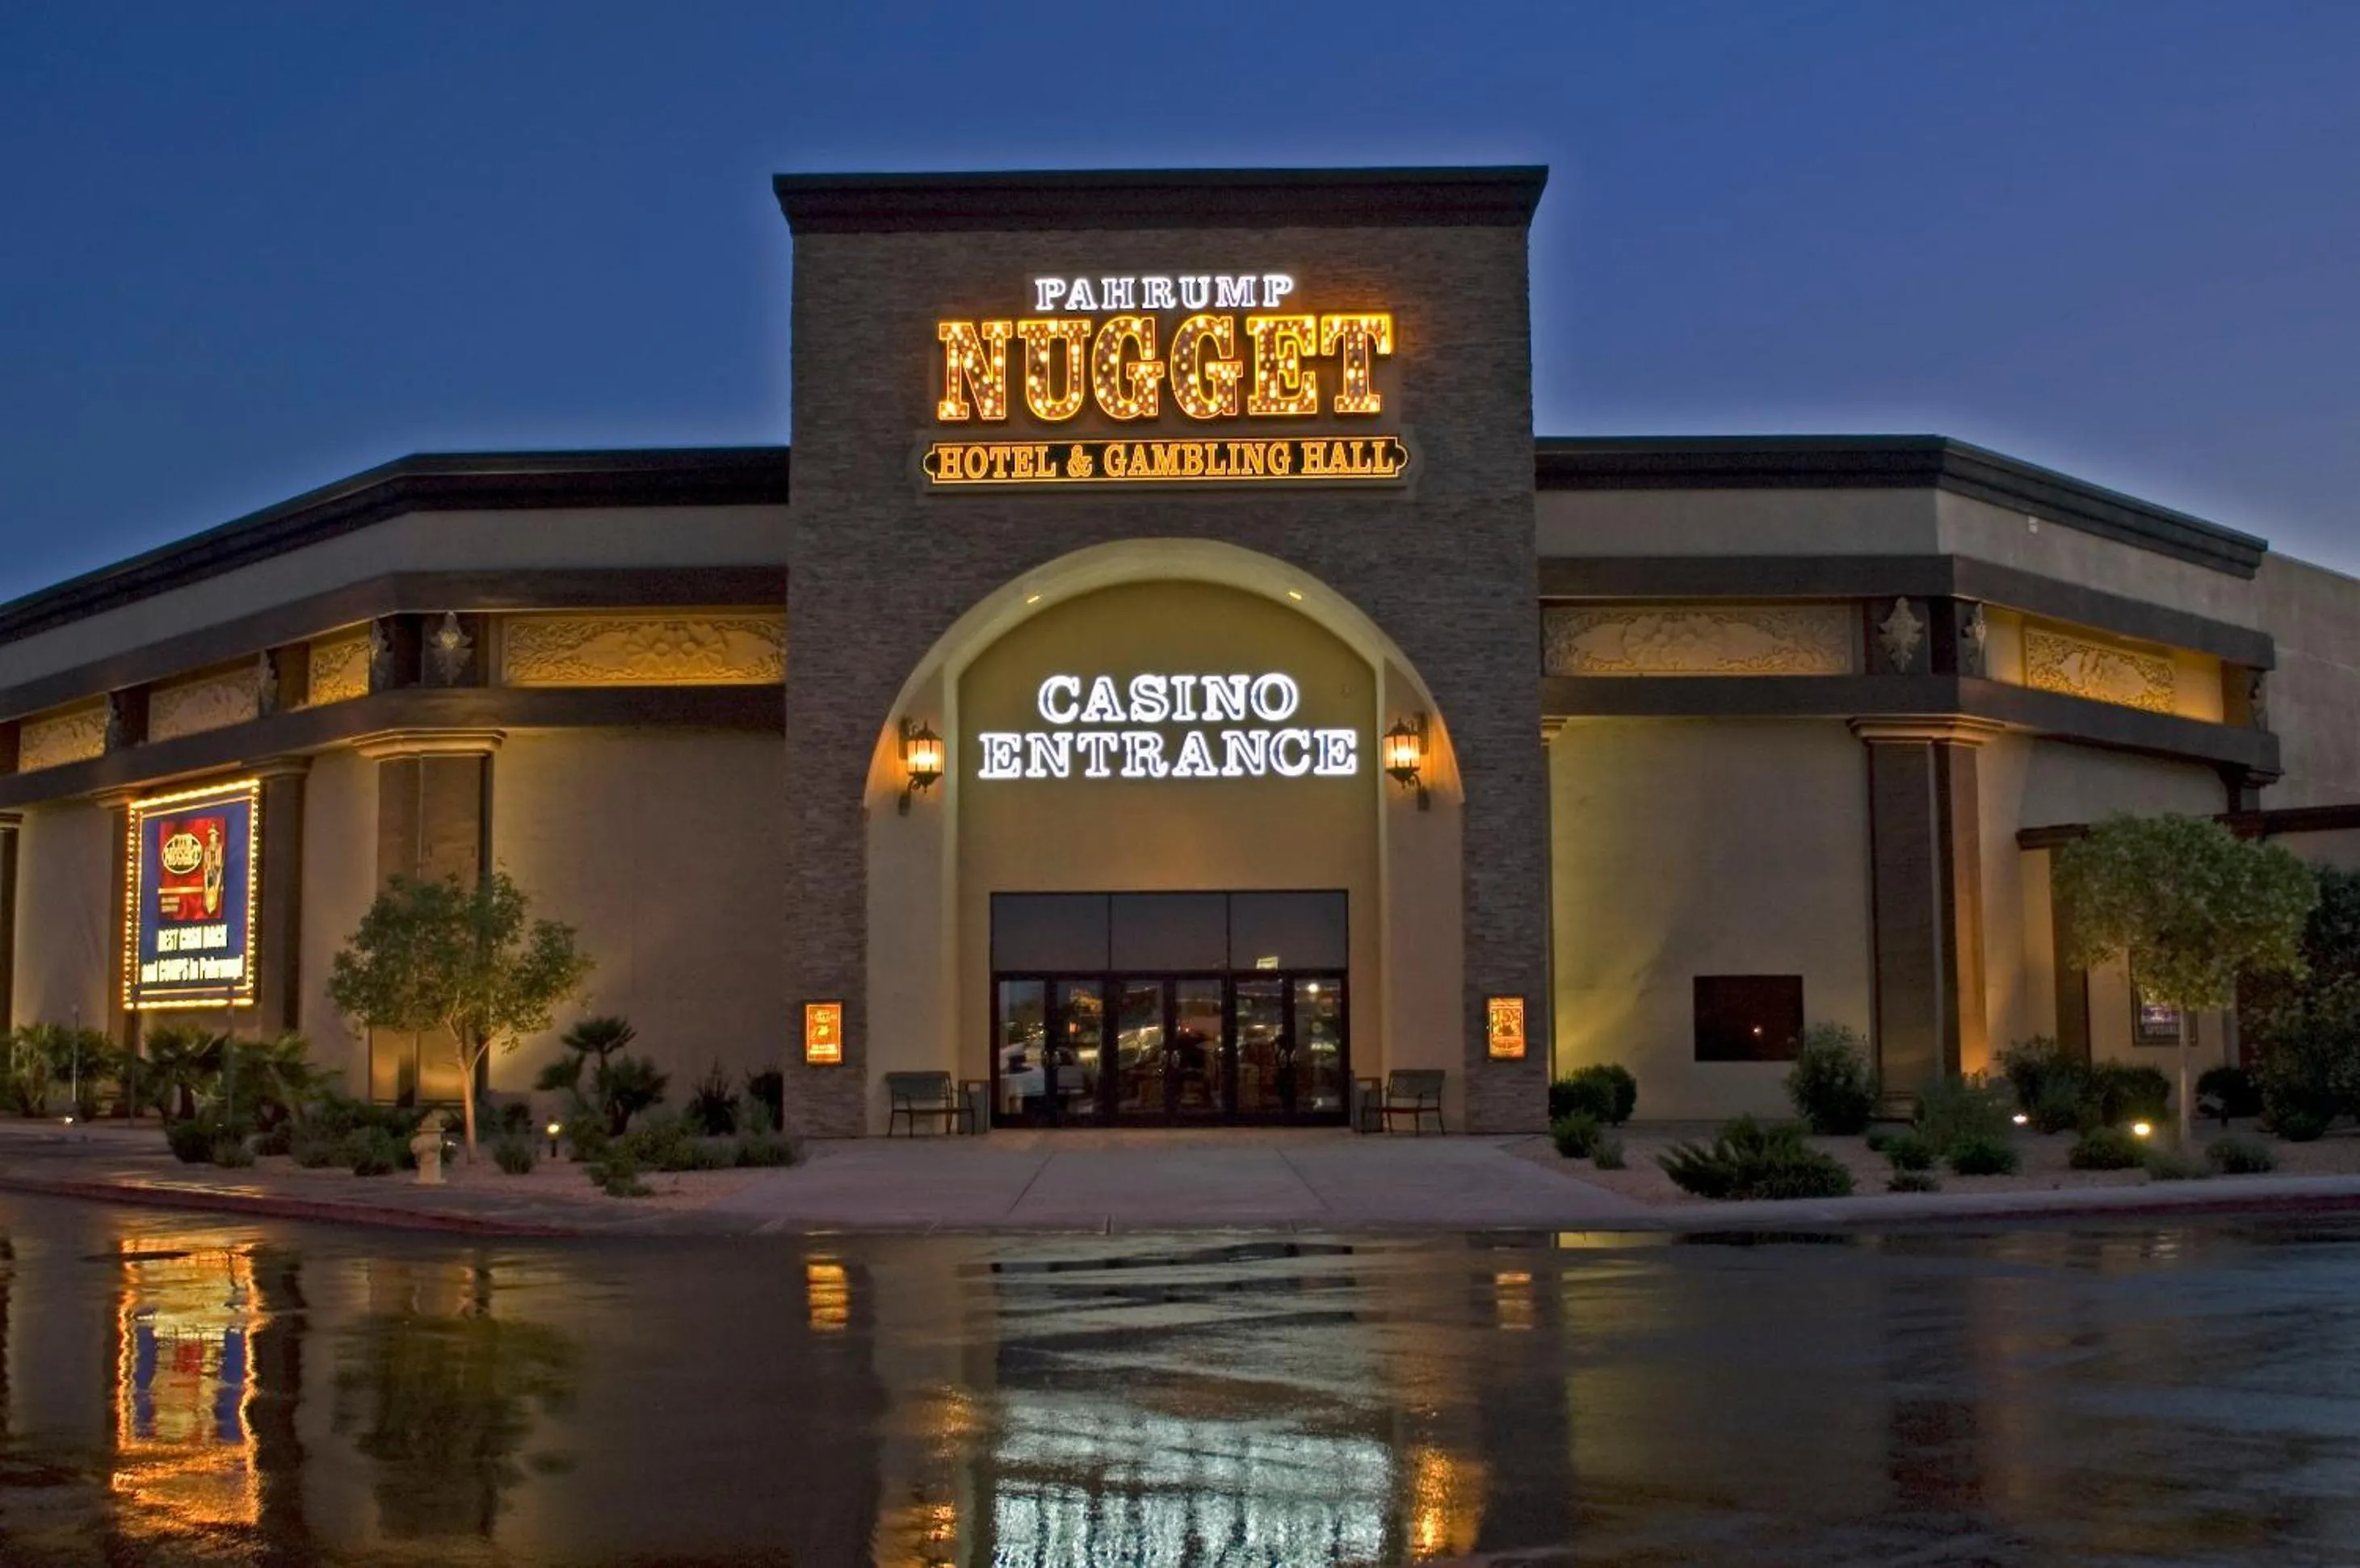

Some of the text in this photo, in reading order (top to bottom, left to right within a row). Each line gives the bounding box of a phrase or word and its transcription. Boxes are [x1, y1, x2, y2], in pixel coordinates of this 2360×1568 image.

[1035, 275, 1294, 311] PAHRUMP
[938, 314, 1392, 420] NUGGET
[938, 441, 1394, 479] HOTEL & GAMBLING HALL
[1037, 673, 1300, 724] CASINO
[978, 728, 1358, 779] ENTRANCE
